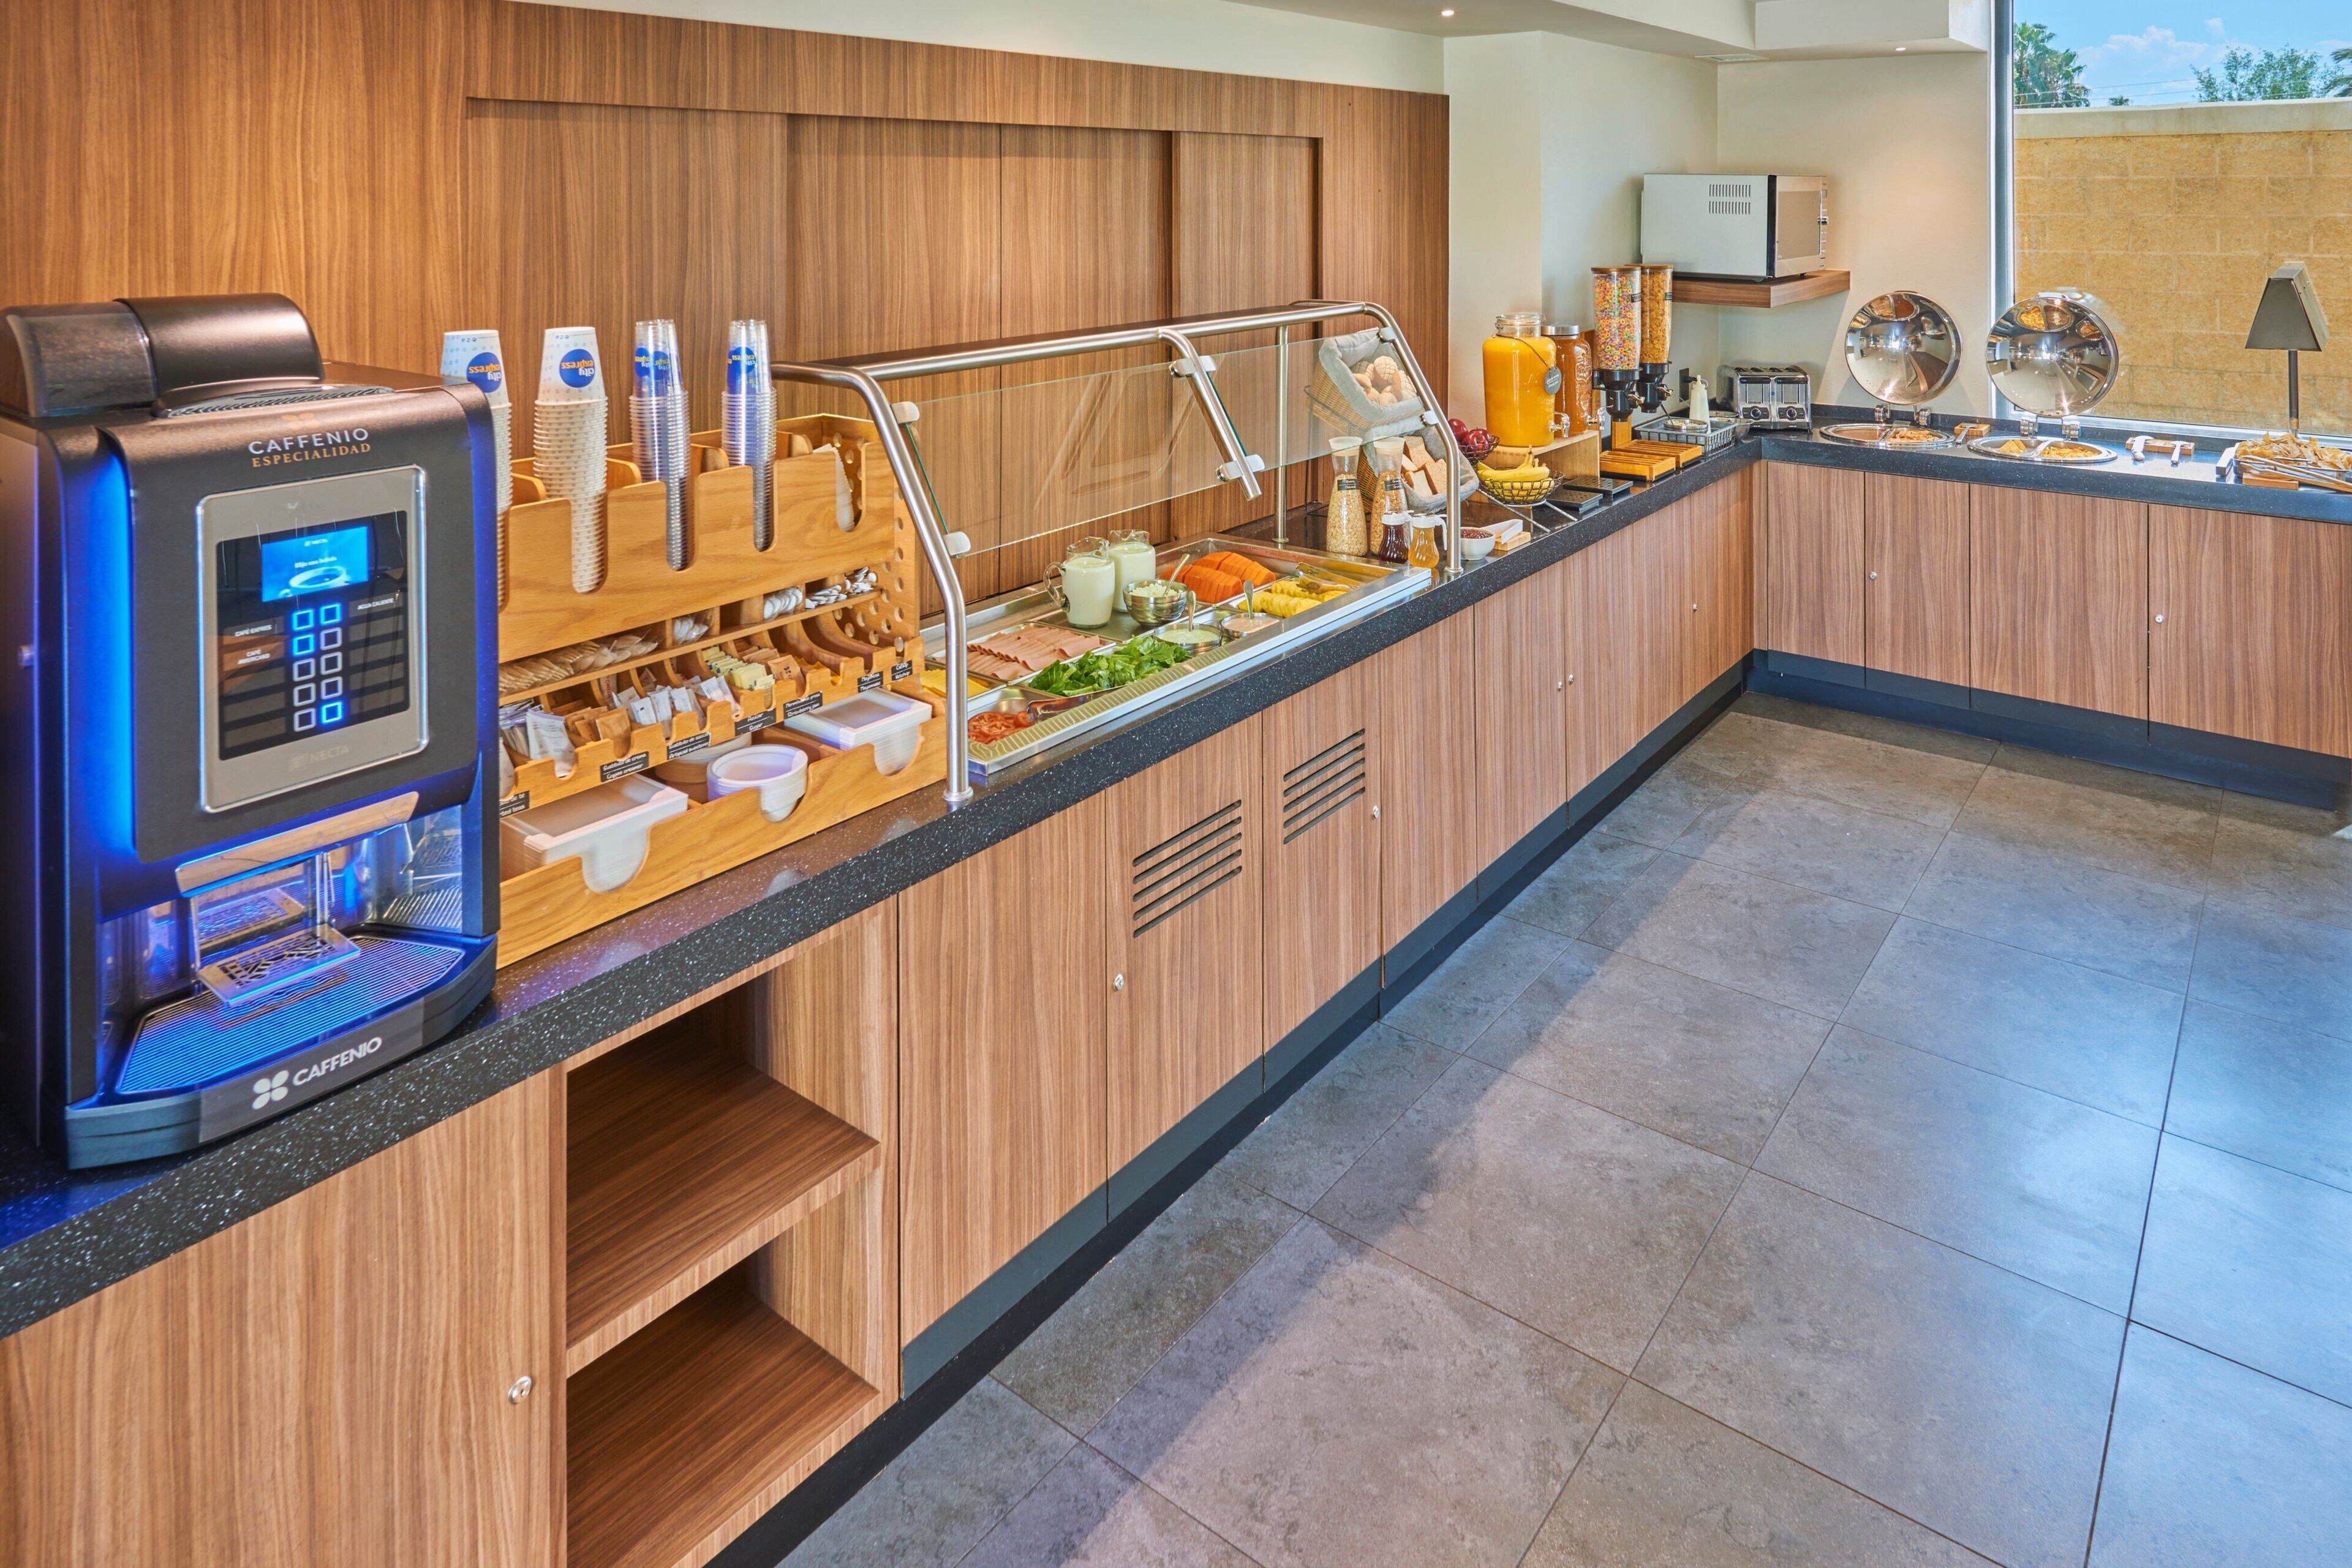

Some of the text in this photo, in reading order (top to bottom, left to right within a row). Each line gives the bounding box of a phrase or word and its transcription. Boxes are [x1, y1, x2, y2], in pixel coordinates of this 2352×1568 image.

[469, 363, 501, 374] express
[561, 359, 594, 369] express
[487, 371, 502, 381] city
[578, 368, 595, 377] city
[247, 428, 369, 454] CAFFENIO
[252, 443, 371, 467] ESPECIALIDAD
[310, 744, 350, 763] NECTA
[292, 1036, 383, 1086] CAFFENIO
